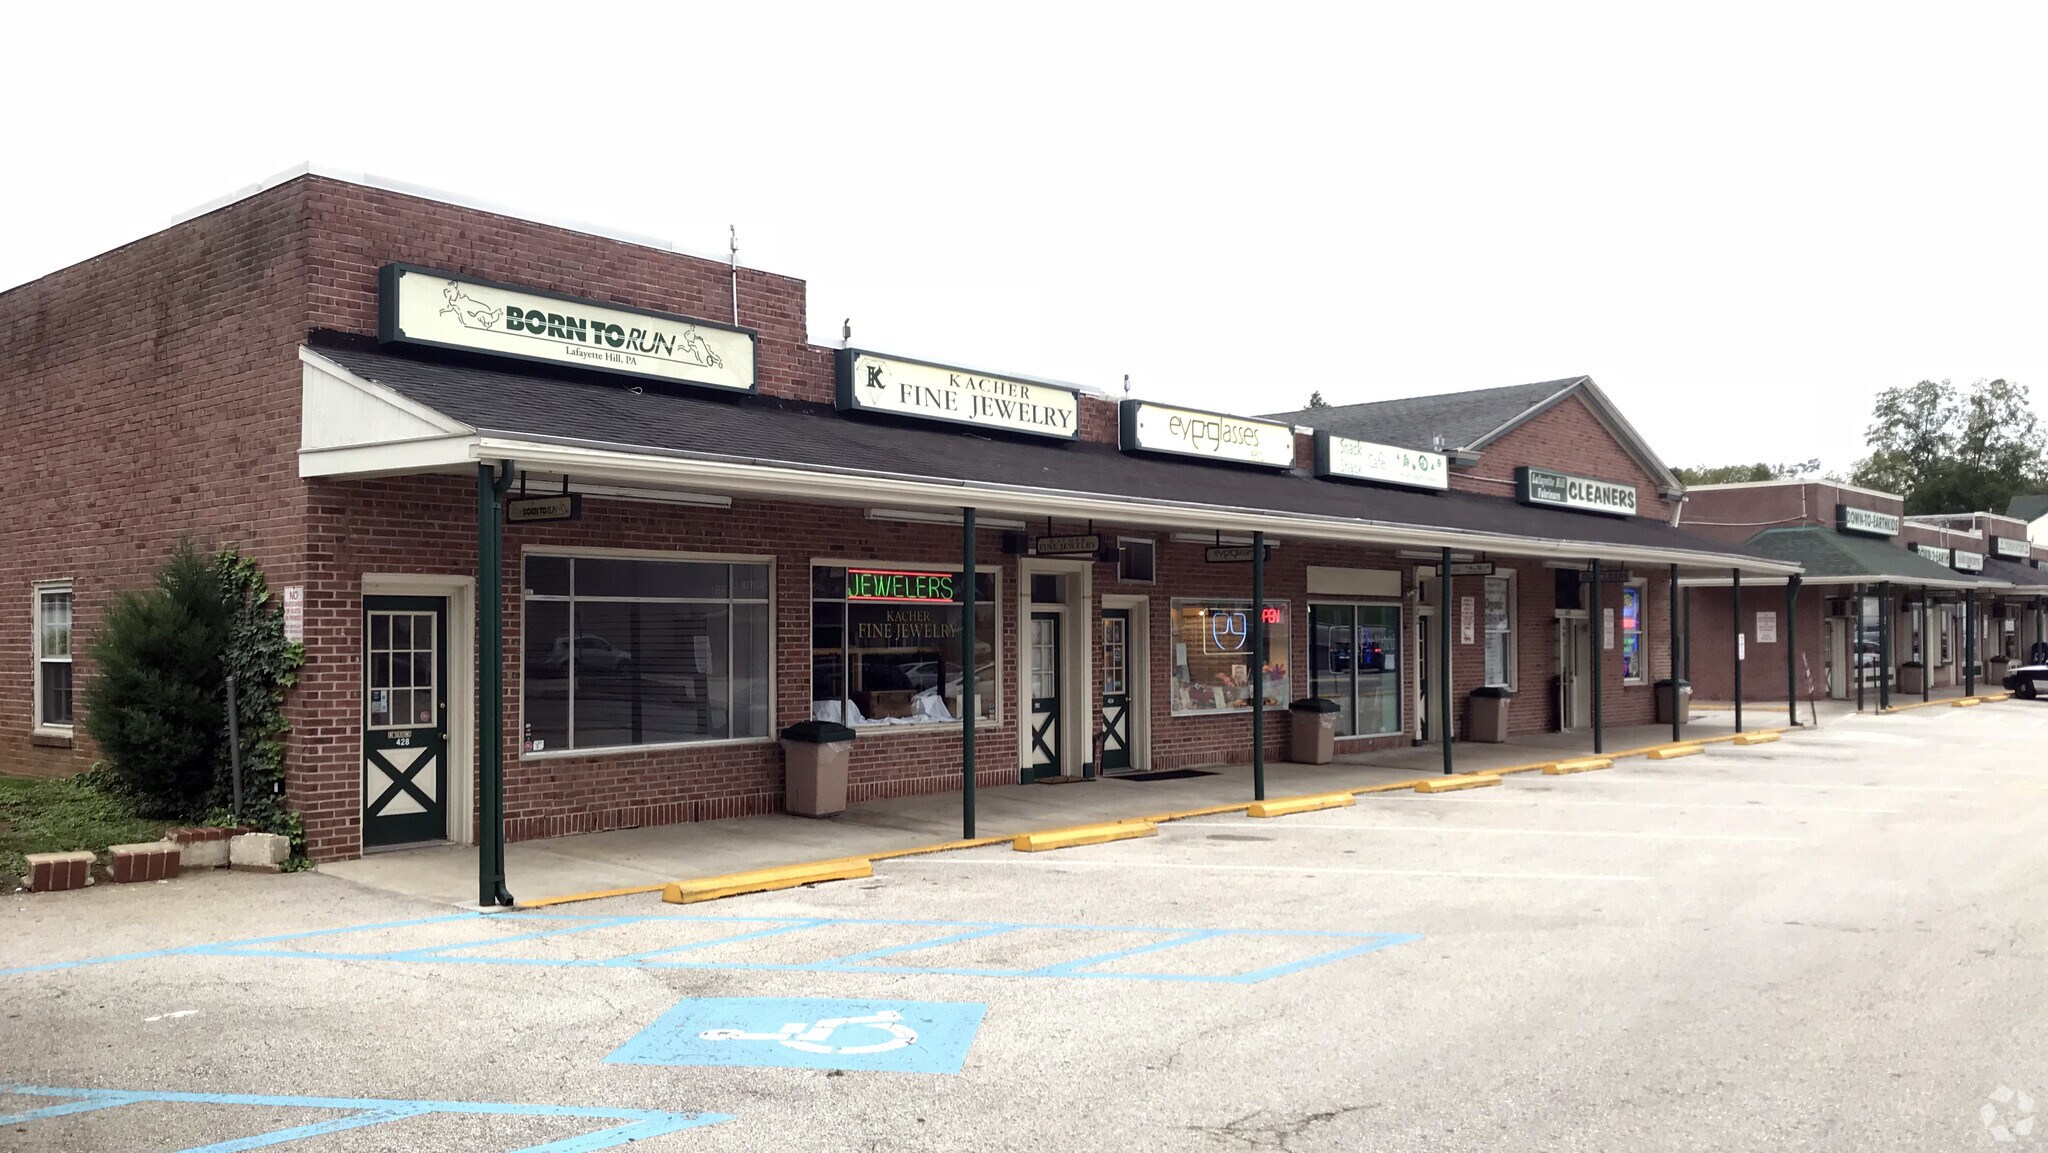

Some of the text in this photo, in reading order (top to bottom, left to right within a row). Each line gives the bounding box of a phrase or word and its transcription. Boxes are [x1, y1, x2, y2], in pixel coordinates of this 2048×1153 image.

[506, 305, 676, 356] BORN TO RUN
[565, 346, 638, 366] Lafayette Hill, PA
[949, 373, 1030, 399] KACHER
[899, 383, 1073, 429] FINE JEWELRY
[1568, 481, 1635, 509] CLEANERS
[289, 590, 299, 600] NO
[849, 573, 953, 599] JEWELERS
[886, 610, 930, 622] KACHER
[1261, 608, 1280, 624] PEN
[858, 623, 957, 641] FINE JEWELRY
[395, 738, 410, 746] 428
